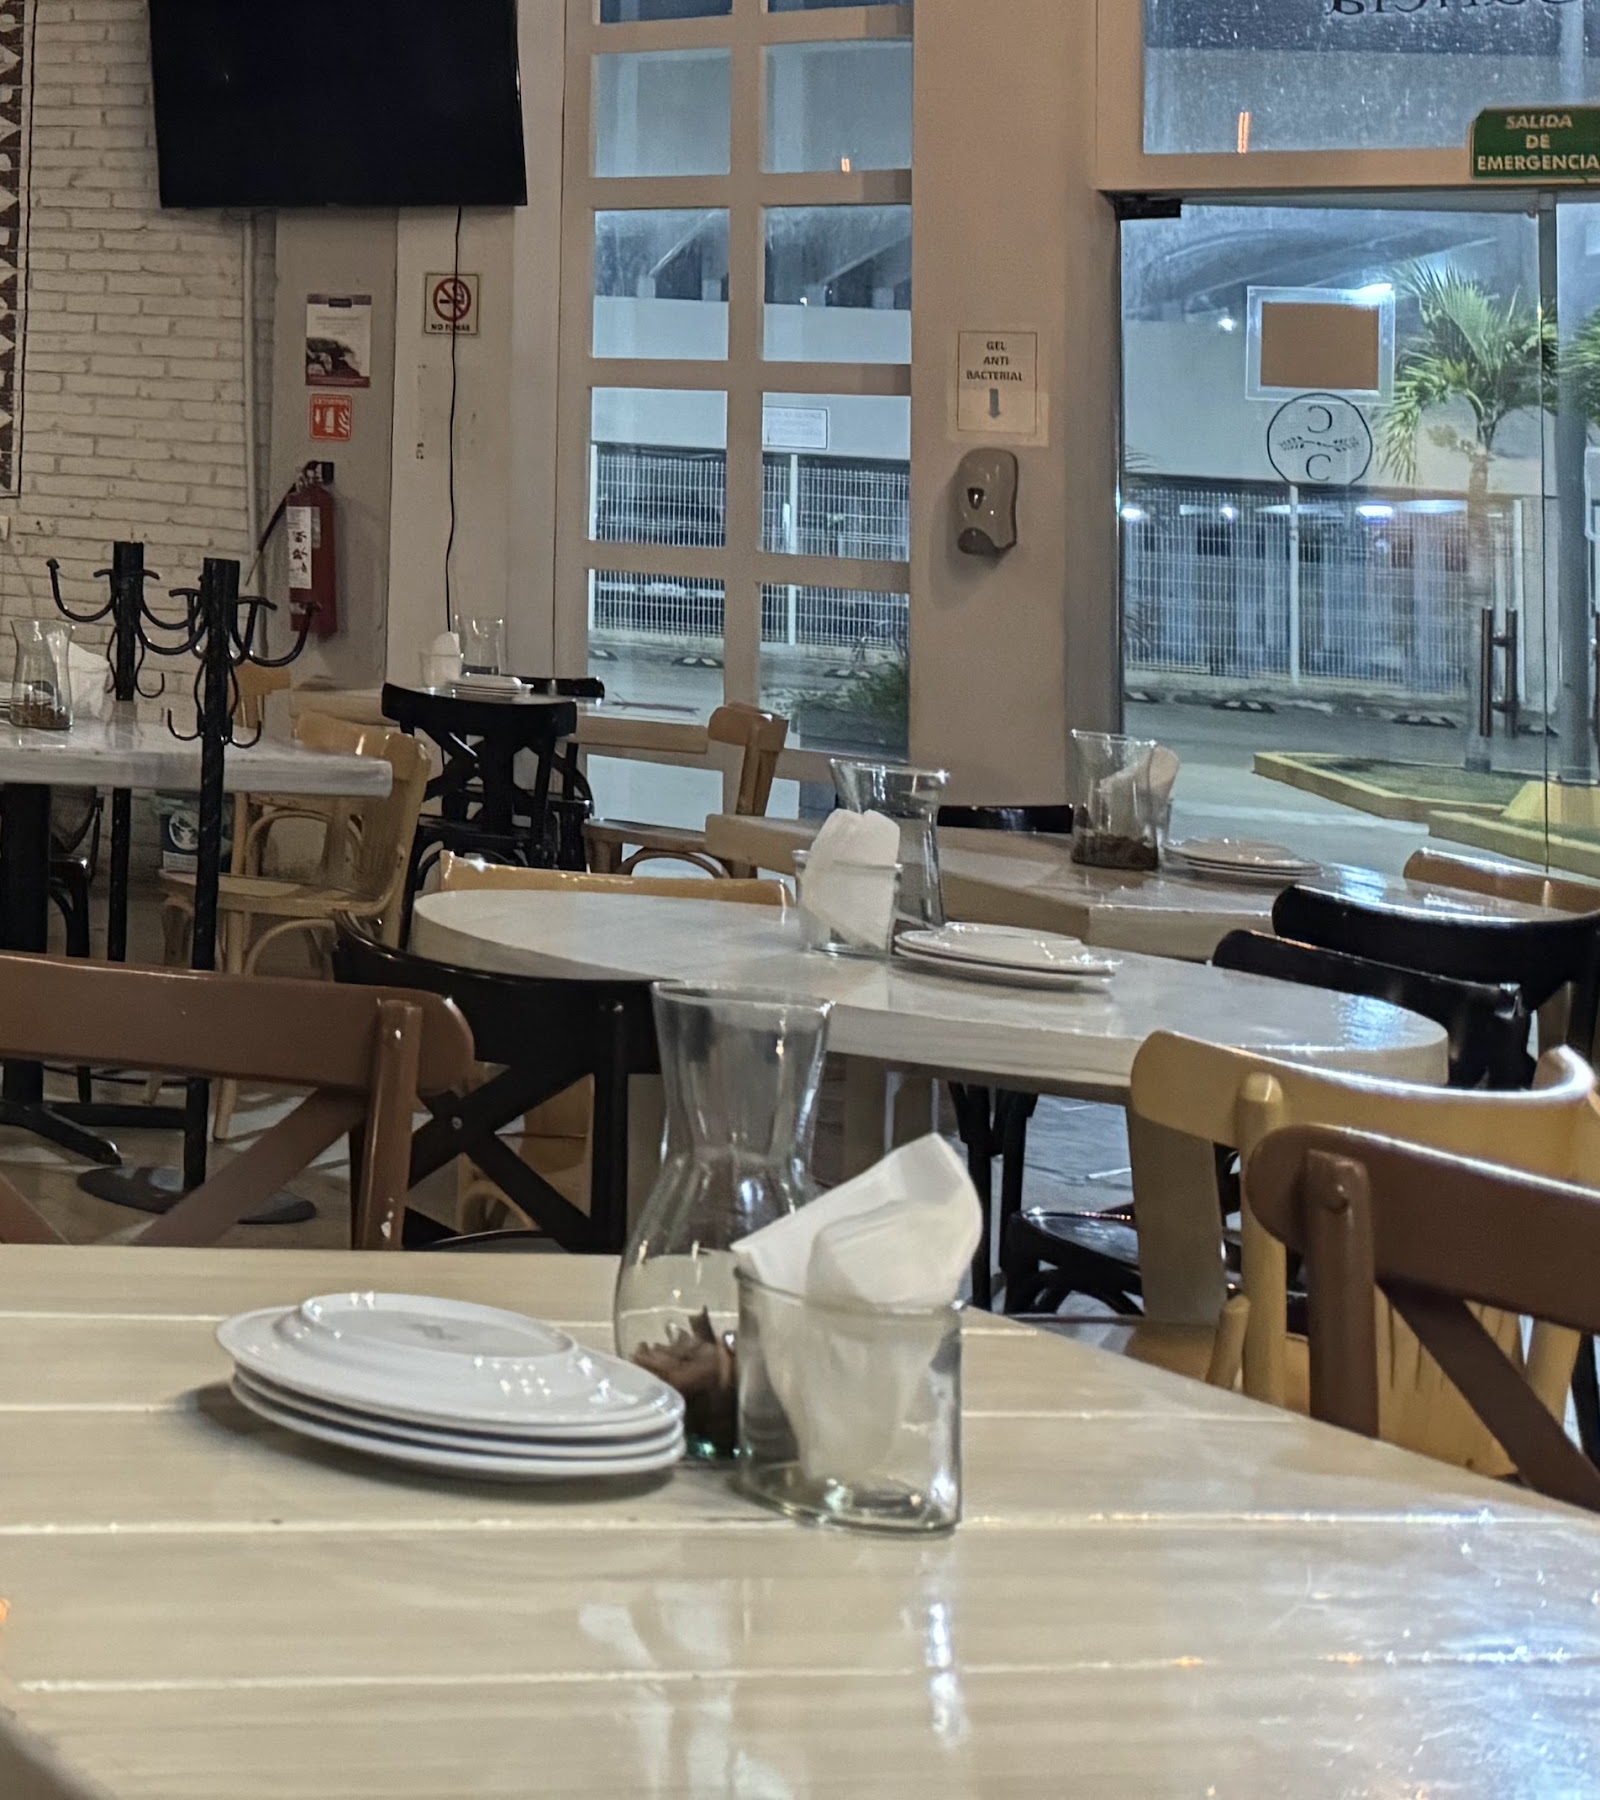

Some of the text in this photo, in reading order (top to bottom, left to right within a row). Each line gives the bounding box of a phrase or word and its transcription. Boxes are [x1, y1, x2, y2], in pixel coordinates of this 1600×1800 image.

[1506, 115, 1573, 130] SALIDA
[1525, 135, 1551, 150] DE
[1477, 155, 1600, 171] EMERGENCIA
[431, 323, 443, 331] NO
[986, 340, 1007, 351] GEL
[983, 355, 1009, 366] ANTI
[966, 370, 1023, 381] BACTERIAL
